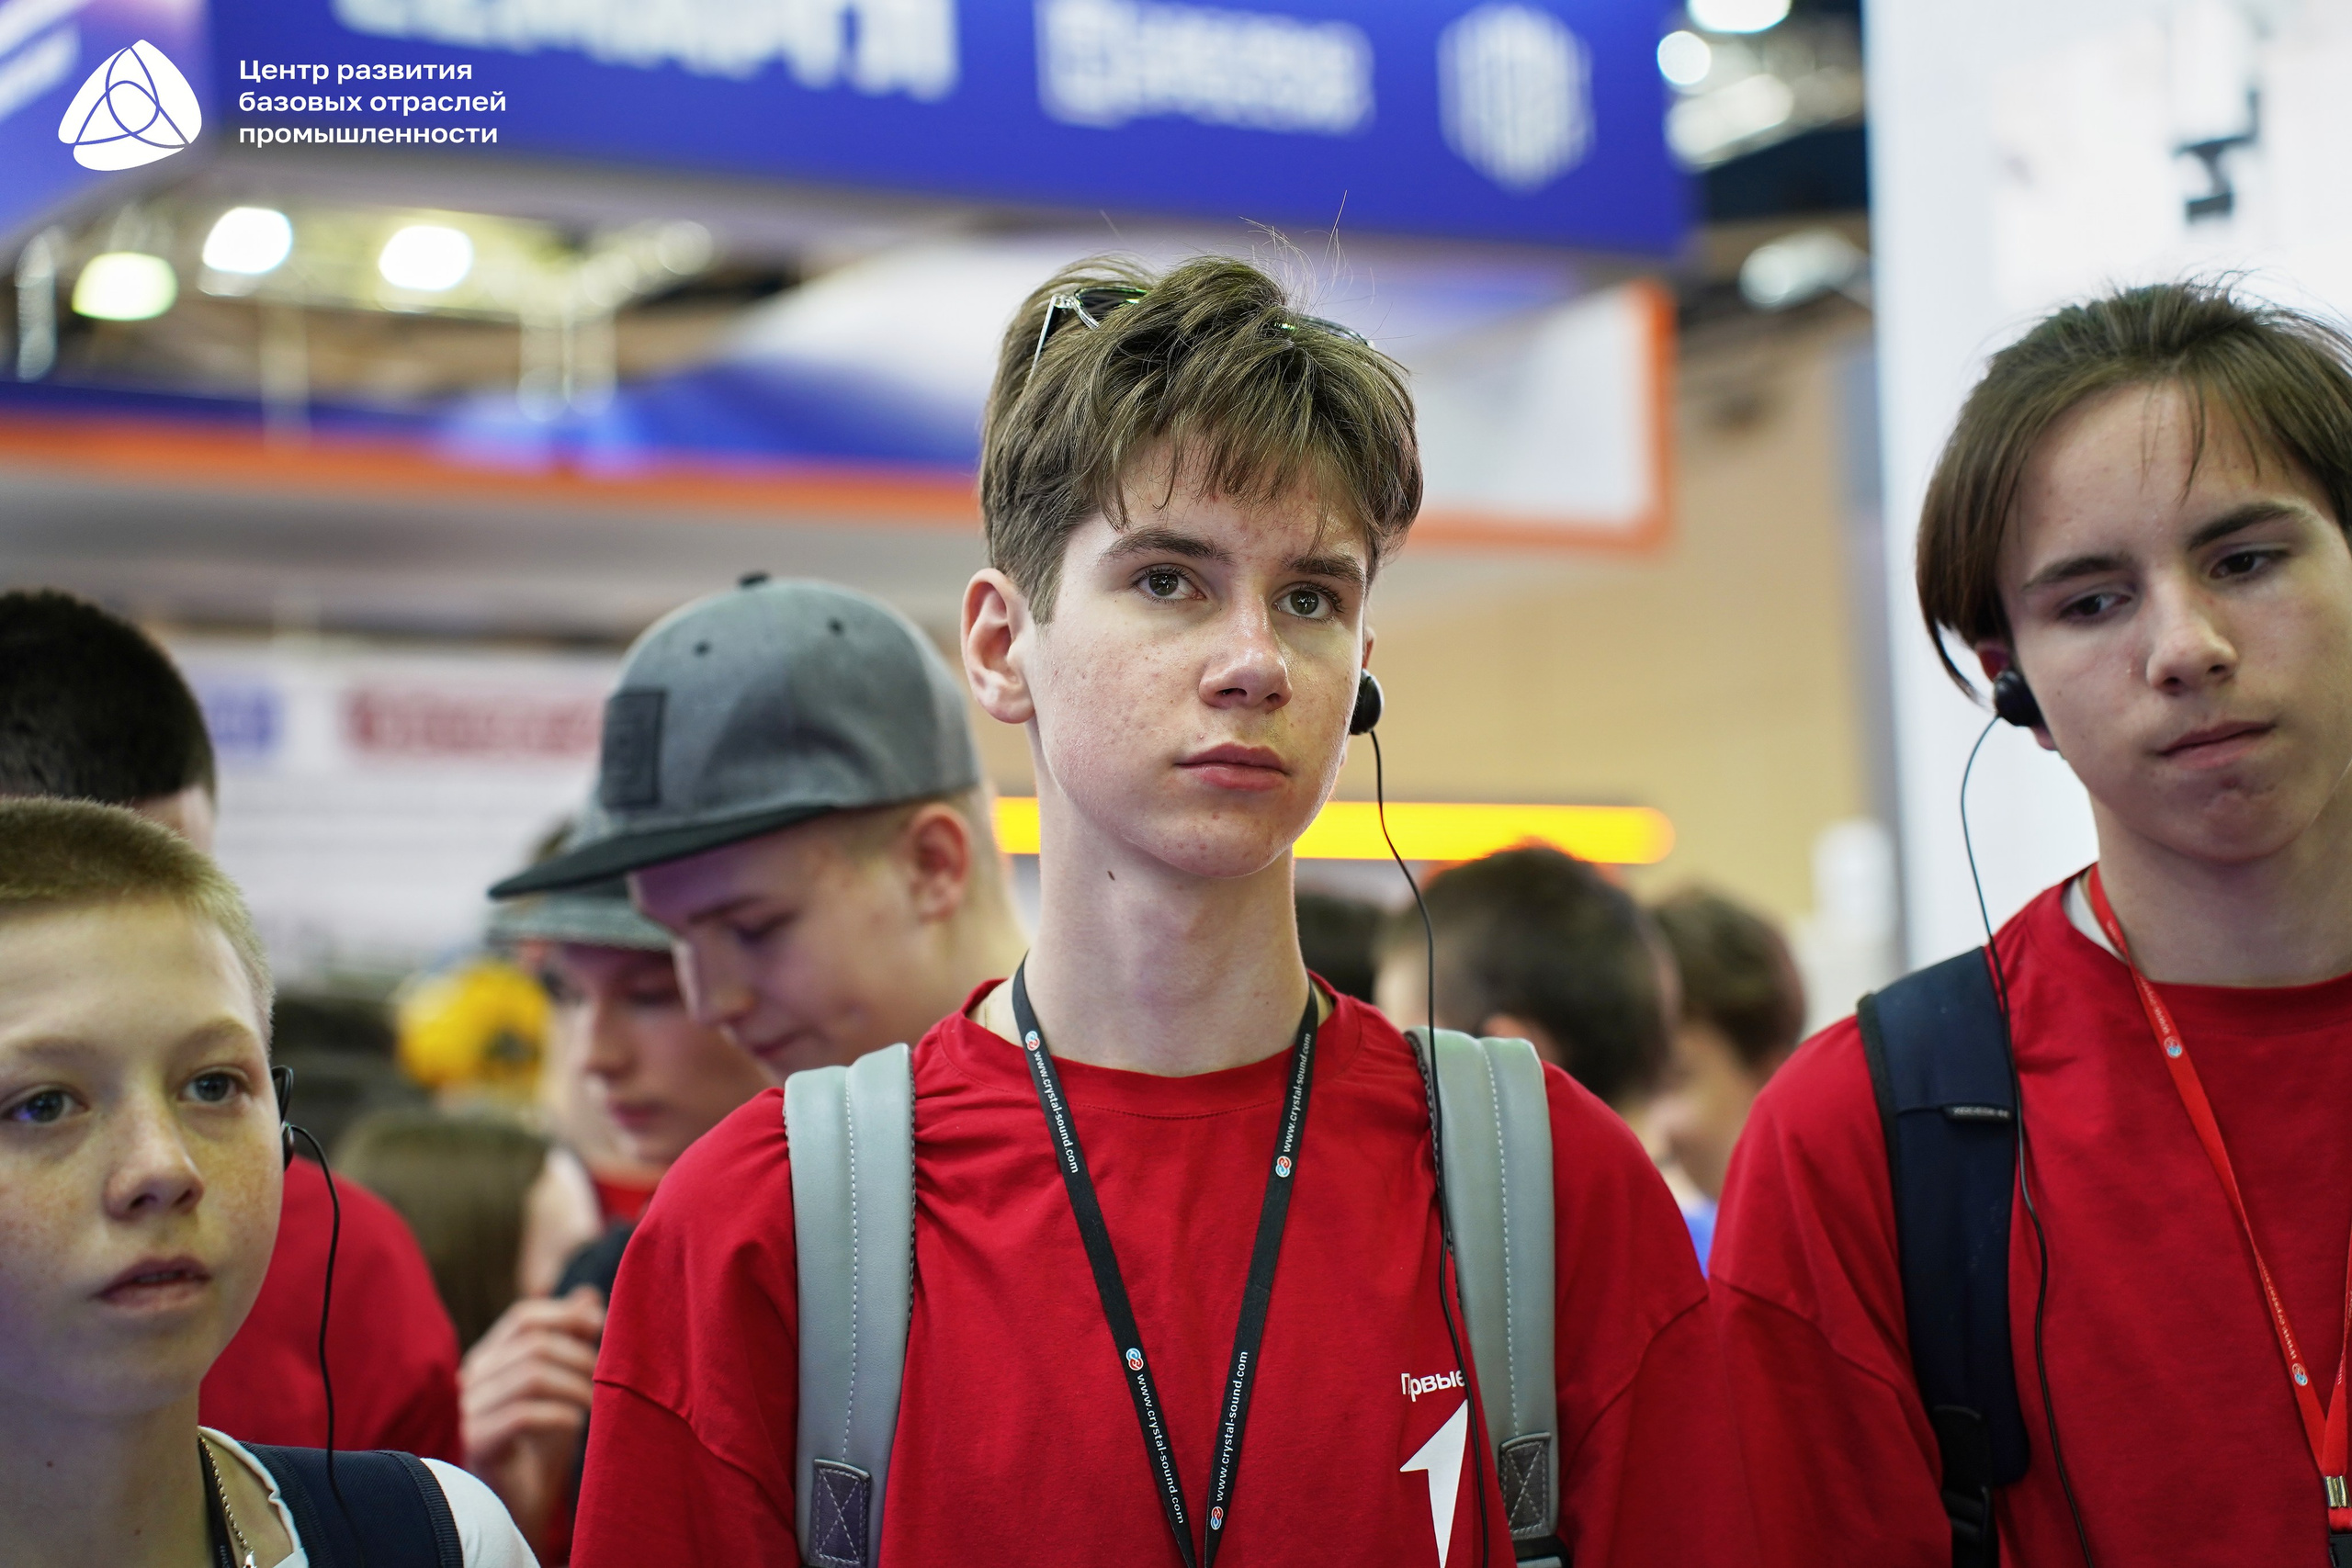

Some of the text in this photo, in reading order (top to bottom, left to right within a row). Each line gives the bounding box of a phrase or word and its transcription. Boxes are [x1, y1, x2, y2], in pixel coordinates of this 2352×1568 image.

[1034, 1051, 1079, 1174] www.crystal-sound.com
[1283, 1032, 1312, 1153] www.crystal-sound.com
[1216, 1351, 1249, 1502] www.crystal-sound.com
[1401, 1371, 1465, 1403] Првые
[1136, 1374, 1184, 1524] www.crystal-sound.com
